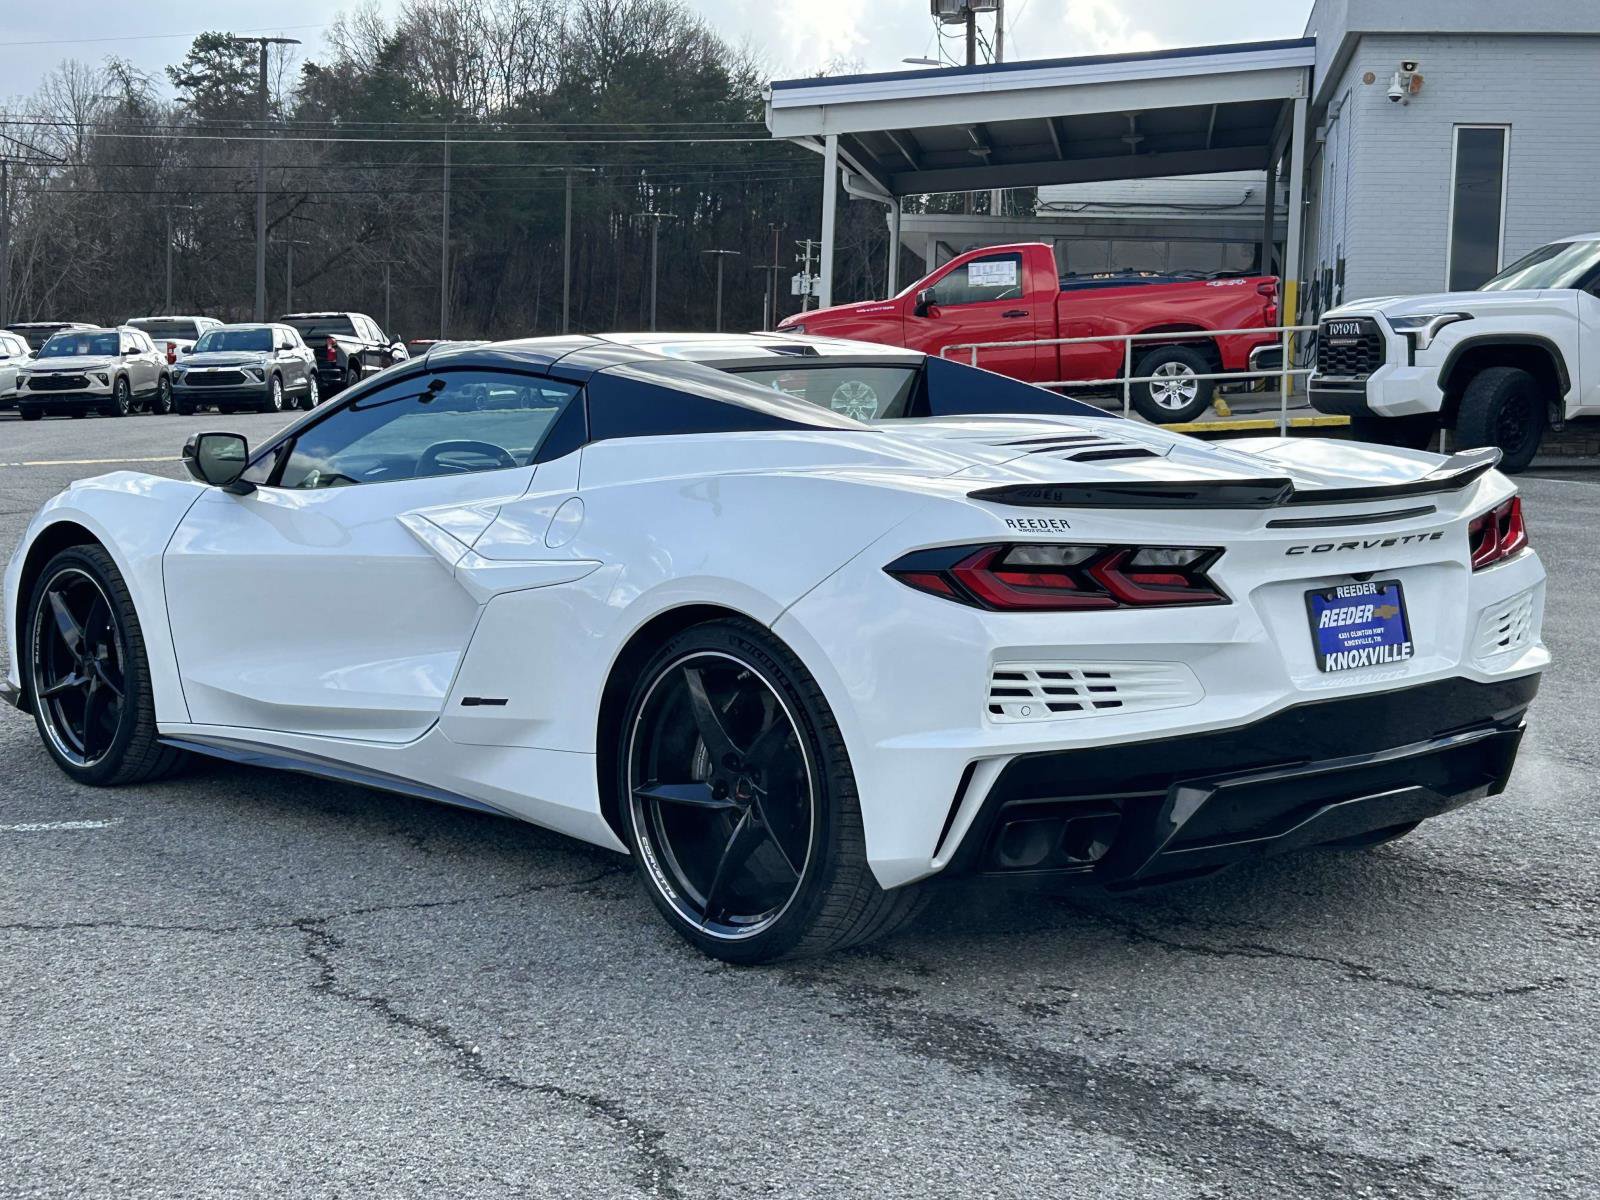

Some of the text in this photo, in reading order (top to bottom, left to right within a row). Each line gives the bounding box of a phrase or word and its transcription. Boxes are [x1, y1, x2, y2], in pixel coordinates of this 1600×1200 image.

[1328, 322, 1360, 335] TOYOTA
[1004, 518, 1071, 529] REEDER
[1285, 530, 1445, 556] CORVETTE
[1336, 582, 1377, 599] REEDER
[1319, 604, 1374, 629] REEDER
[1350, 629, 1373, 638] CLINTON
[741, 638, 790, 690] MICHELIN
[1325, 641, 1411, 672] KNOXVILLE
[642, 836, 677, 899] CORVETTE
